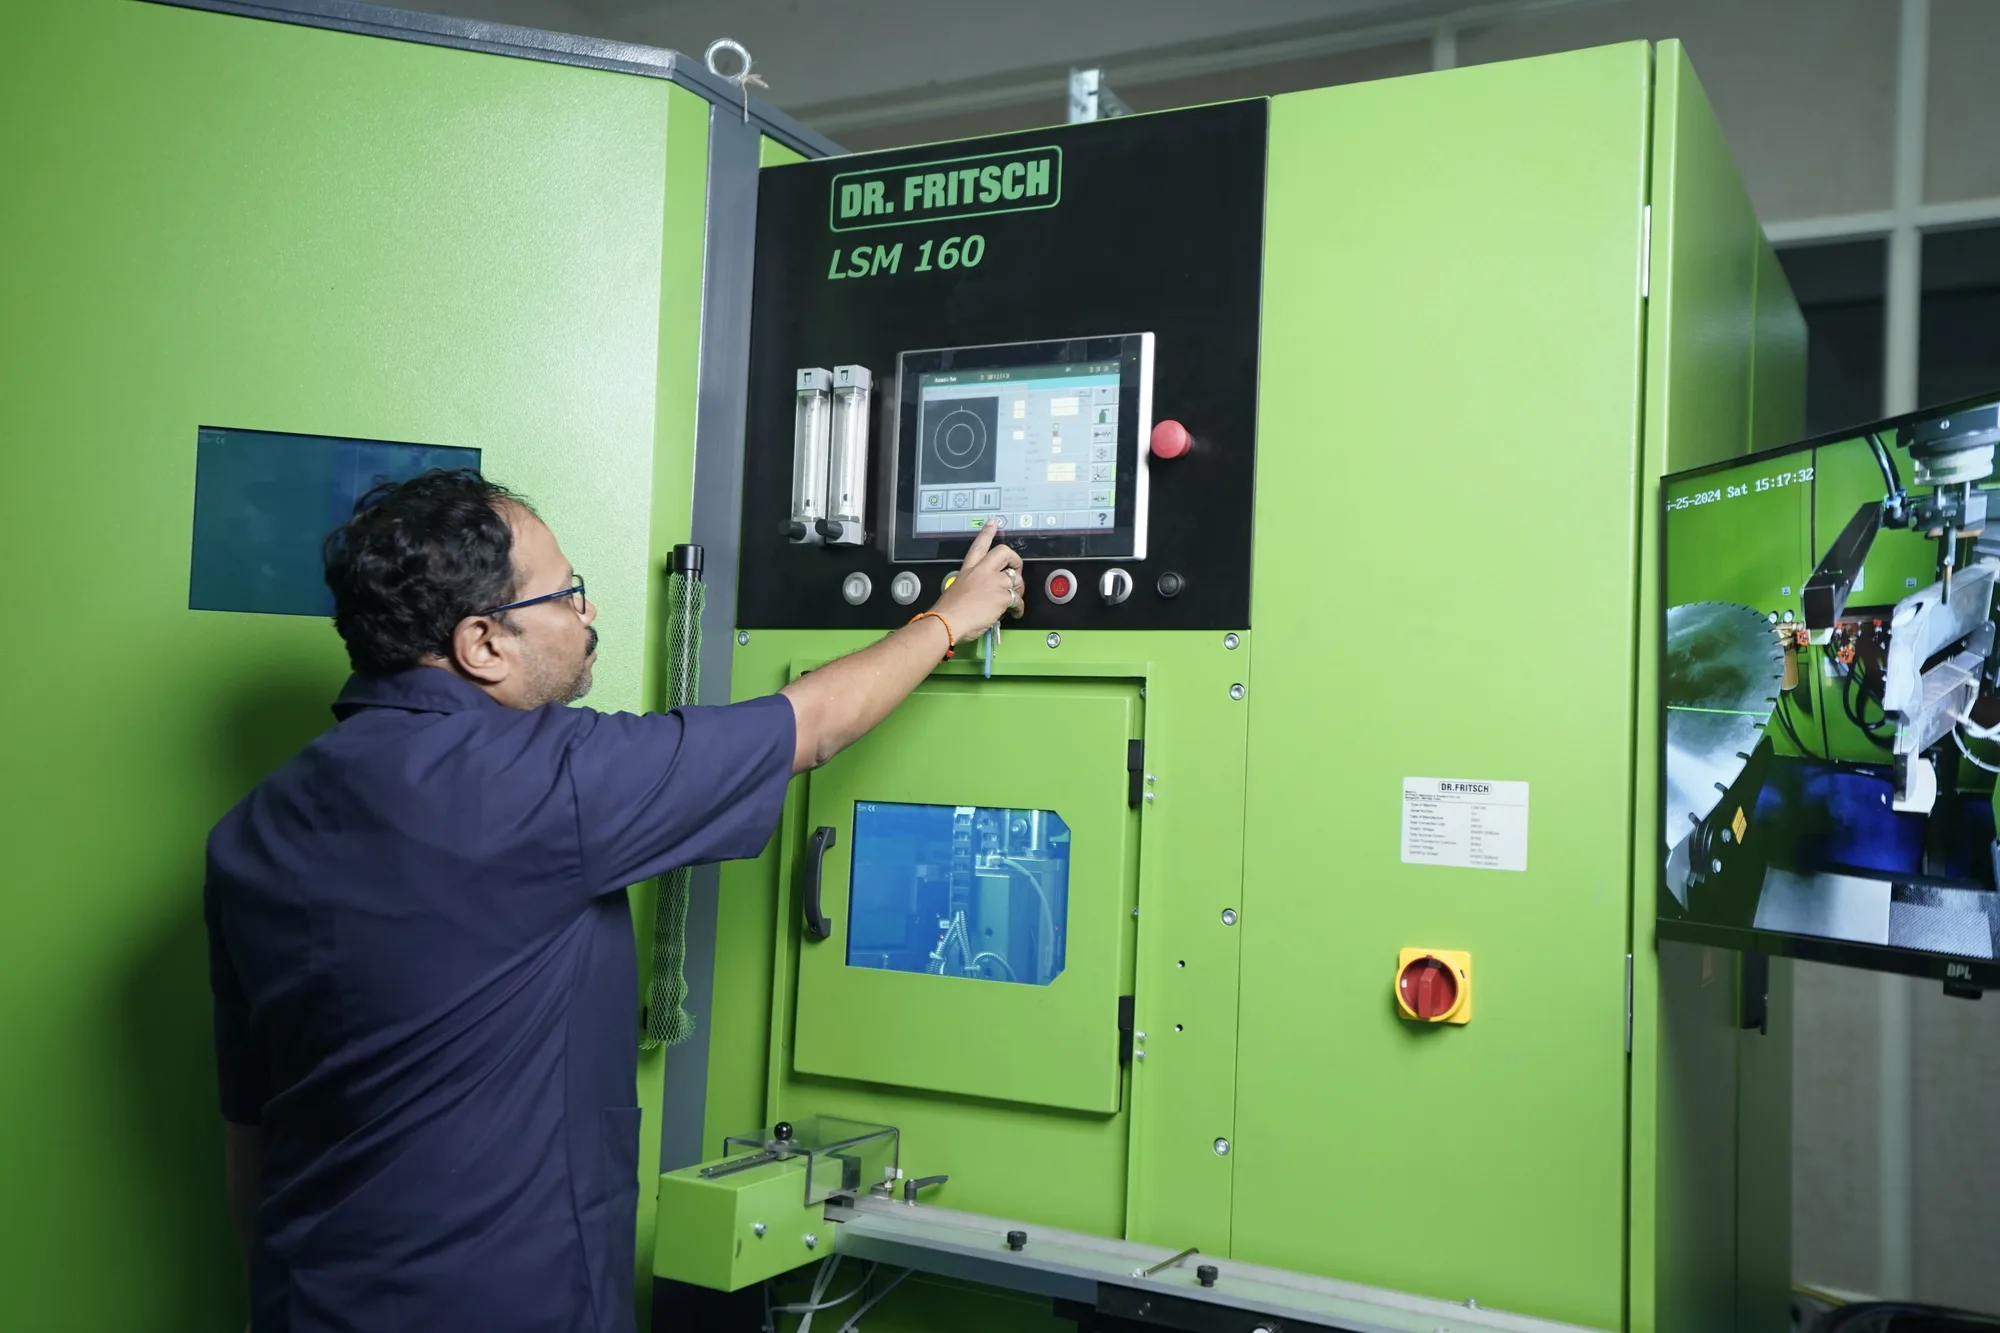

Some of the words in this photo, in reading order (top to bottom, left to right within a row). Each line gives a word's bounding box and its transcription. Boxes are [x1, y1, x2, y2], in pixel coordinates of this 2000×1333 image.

[840, 180, 895, 219] DR.
[904, 158, 1051, 212] FRITSCH
[827, 242, 904, 280] LSM
[913, 234, 986, 273] 160
[1726, 483, 1748, 499] Sat
[1754, 467, 1815, 492] 15:17:32
